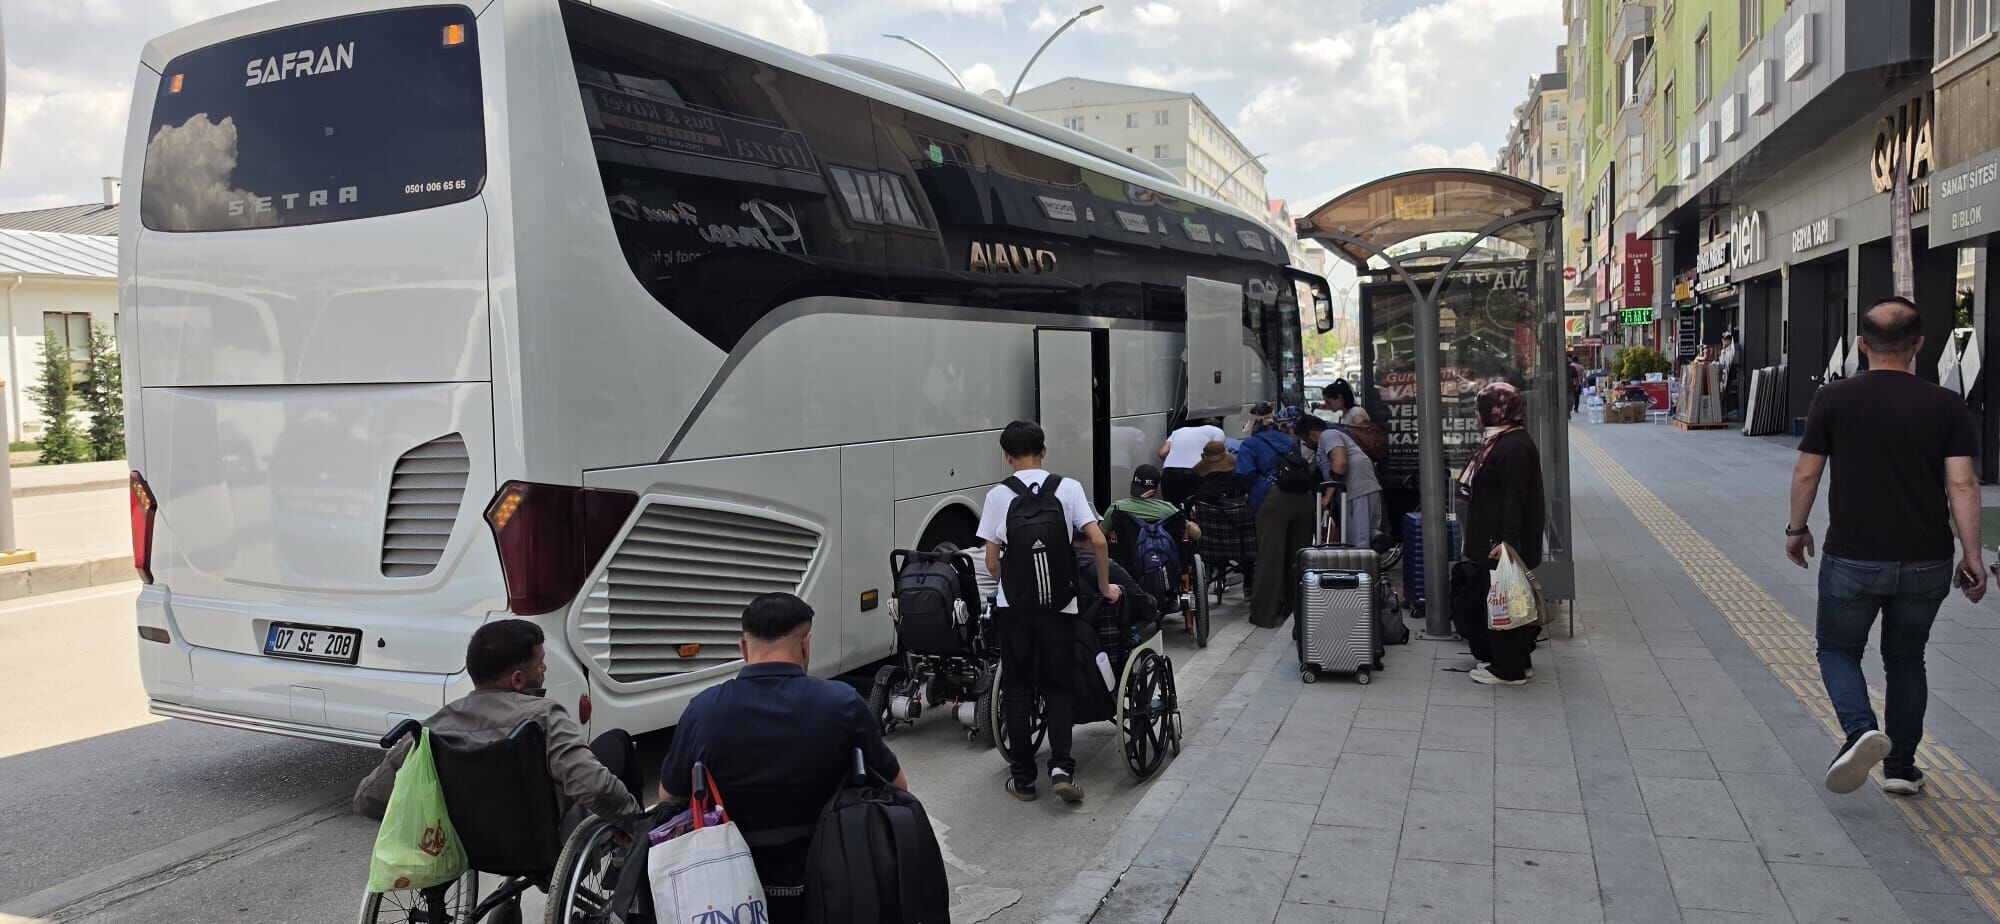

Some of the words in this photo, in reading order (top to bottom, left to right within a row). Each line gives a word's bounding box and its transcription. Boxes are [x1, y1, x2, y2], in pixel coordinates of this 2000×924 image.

[245, 41, 355, 87] SAFRAN
[405, 184, 424, 194] 0501
[426, 182, 441, 192] 006
[443, 180, 454, 190] 65
[455, 179, 466, 189] 65
[1941, 173, 1968, 199] SANAT
[1969, 157, 1998, 189] SİTESİ
[228, 186, 358, 217] SETRA
[1959, 204, 1983, 228] BLOK
[1792, 224, 1812, 253] DERYA
[1812, 218, 1829, 246] YAPI
[275, 629, 294, 650] 07
[298, 632, 316, 653] SE
[325, 634, 352, 656] 208
